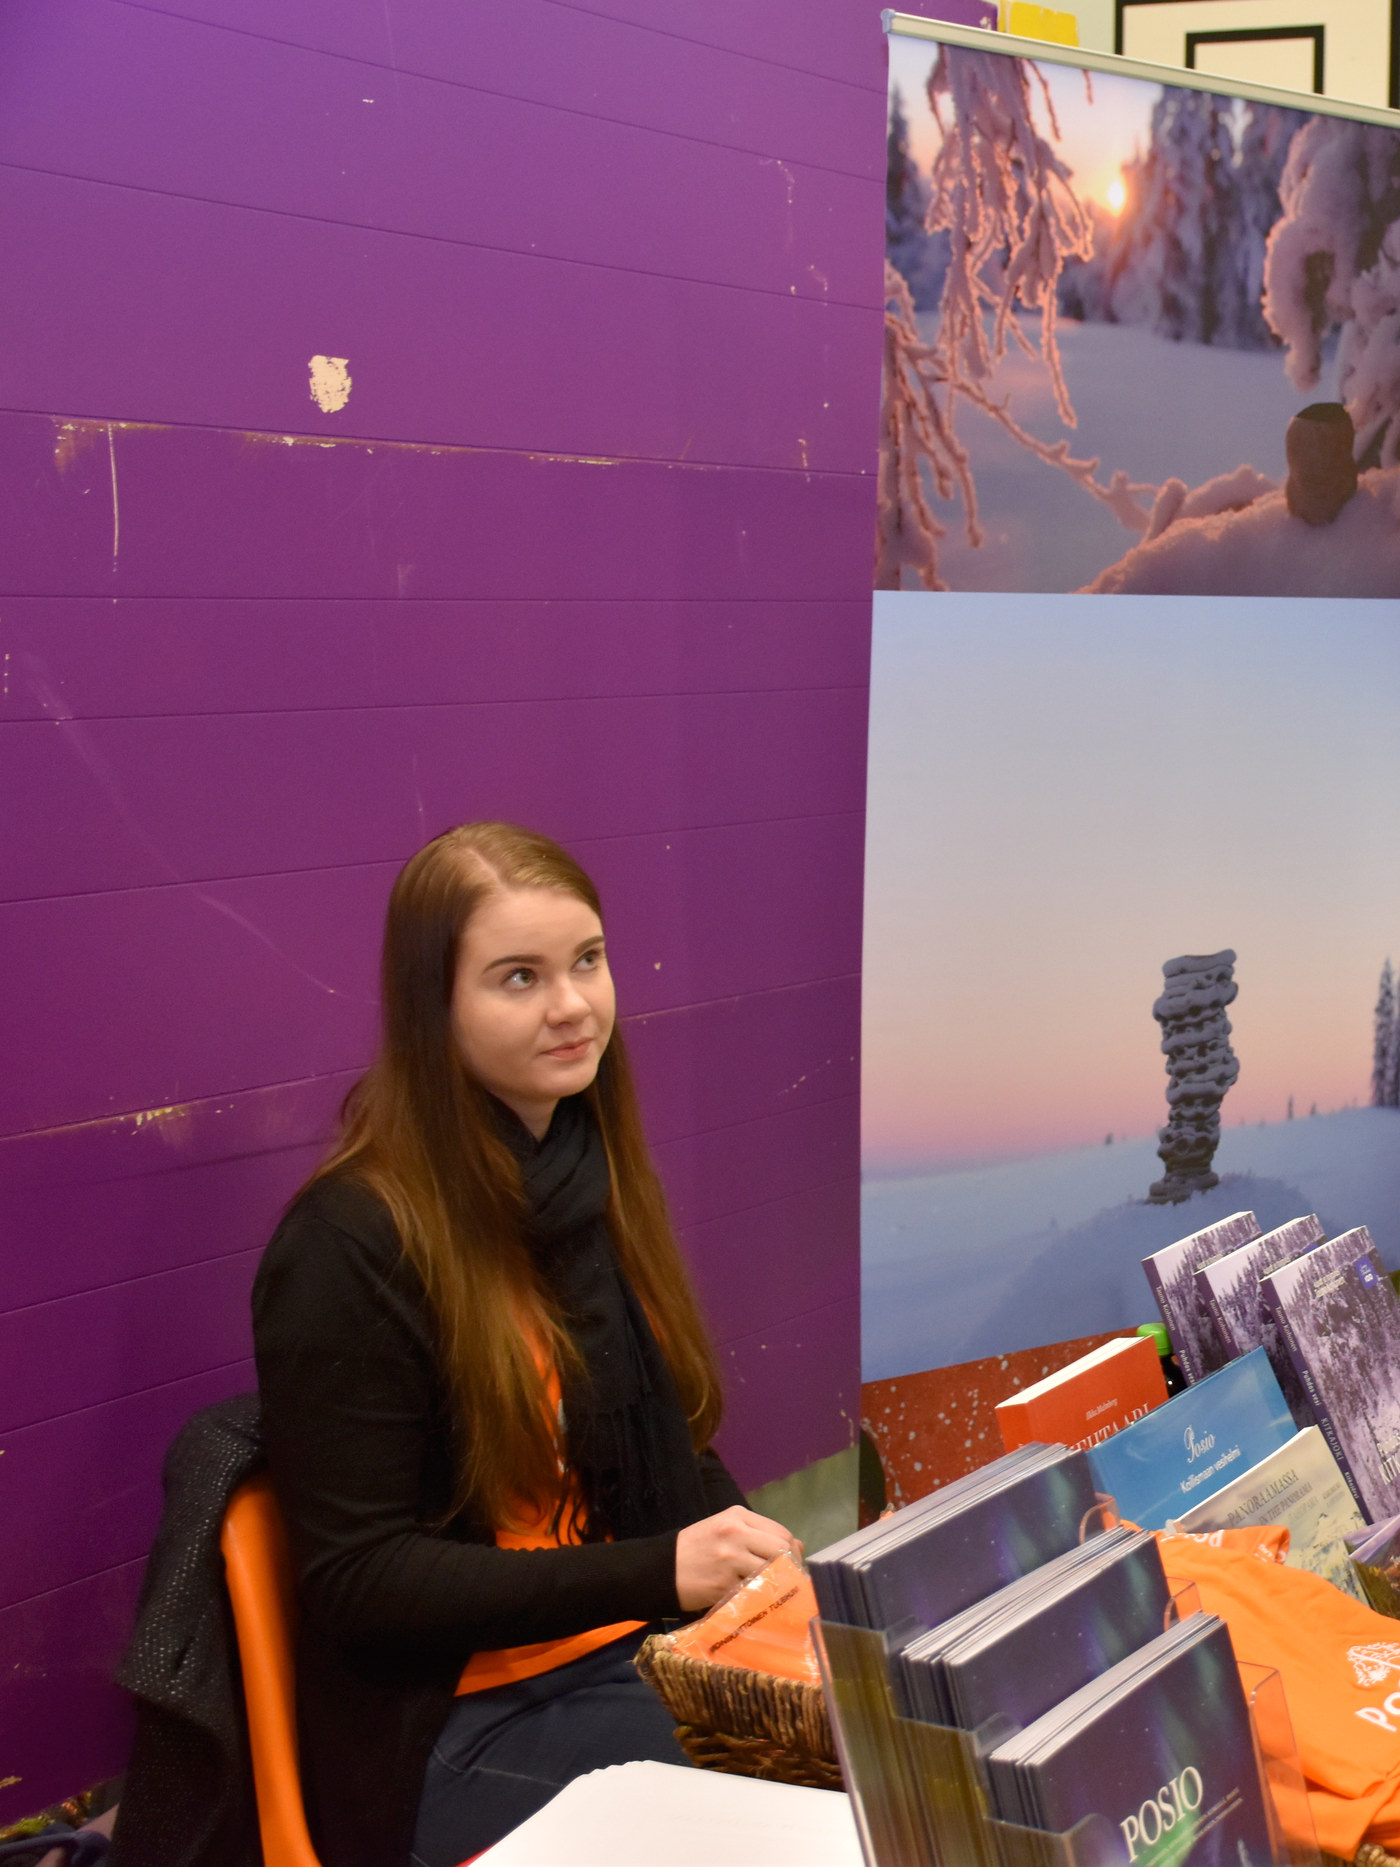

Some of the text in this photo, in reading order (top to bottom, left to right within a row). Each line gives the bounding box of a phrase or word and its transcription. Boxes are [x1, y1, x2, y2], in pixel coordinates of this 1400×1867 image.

[1183, 1424, 1216, 1464] Posio
[1320, 1417, 1345, 1461] KITKAJOKI
[1226, 1468, 1300, 1526] PANORAAMASSA
[1119, 1765, 1204, 1864] POSIO
